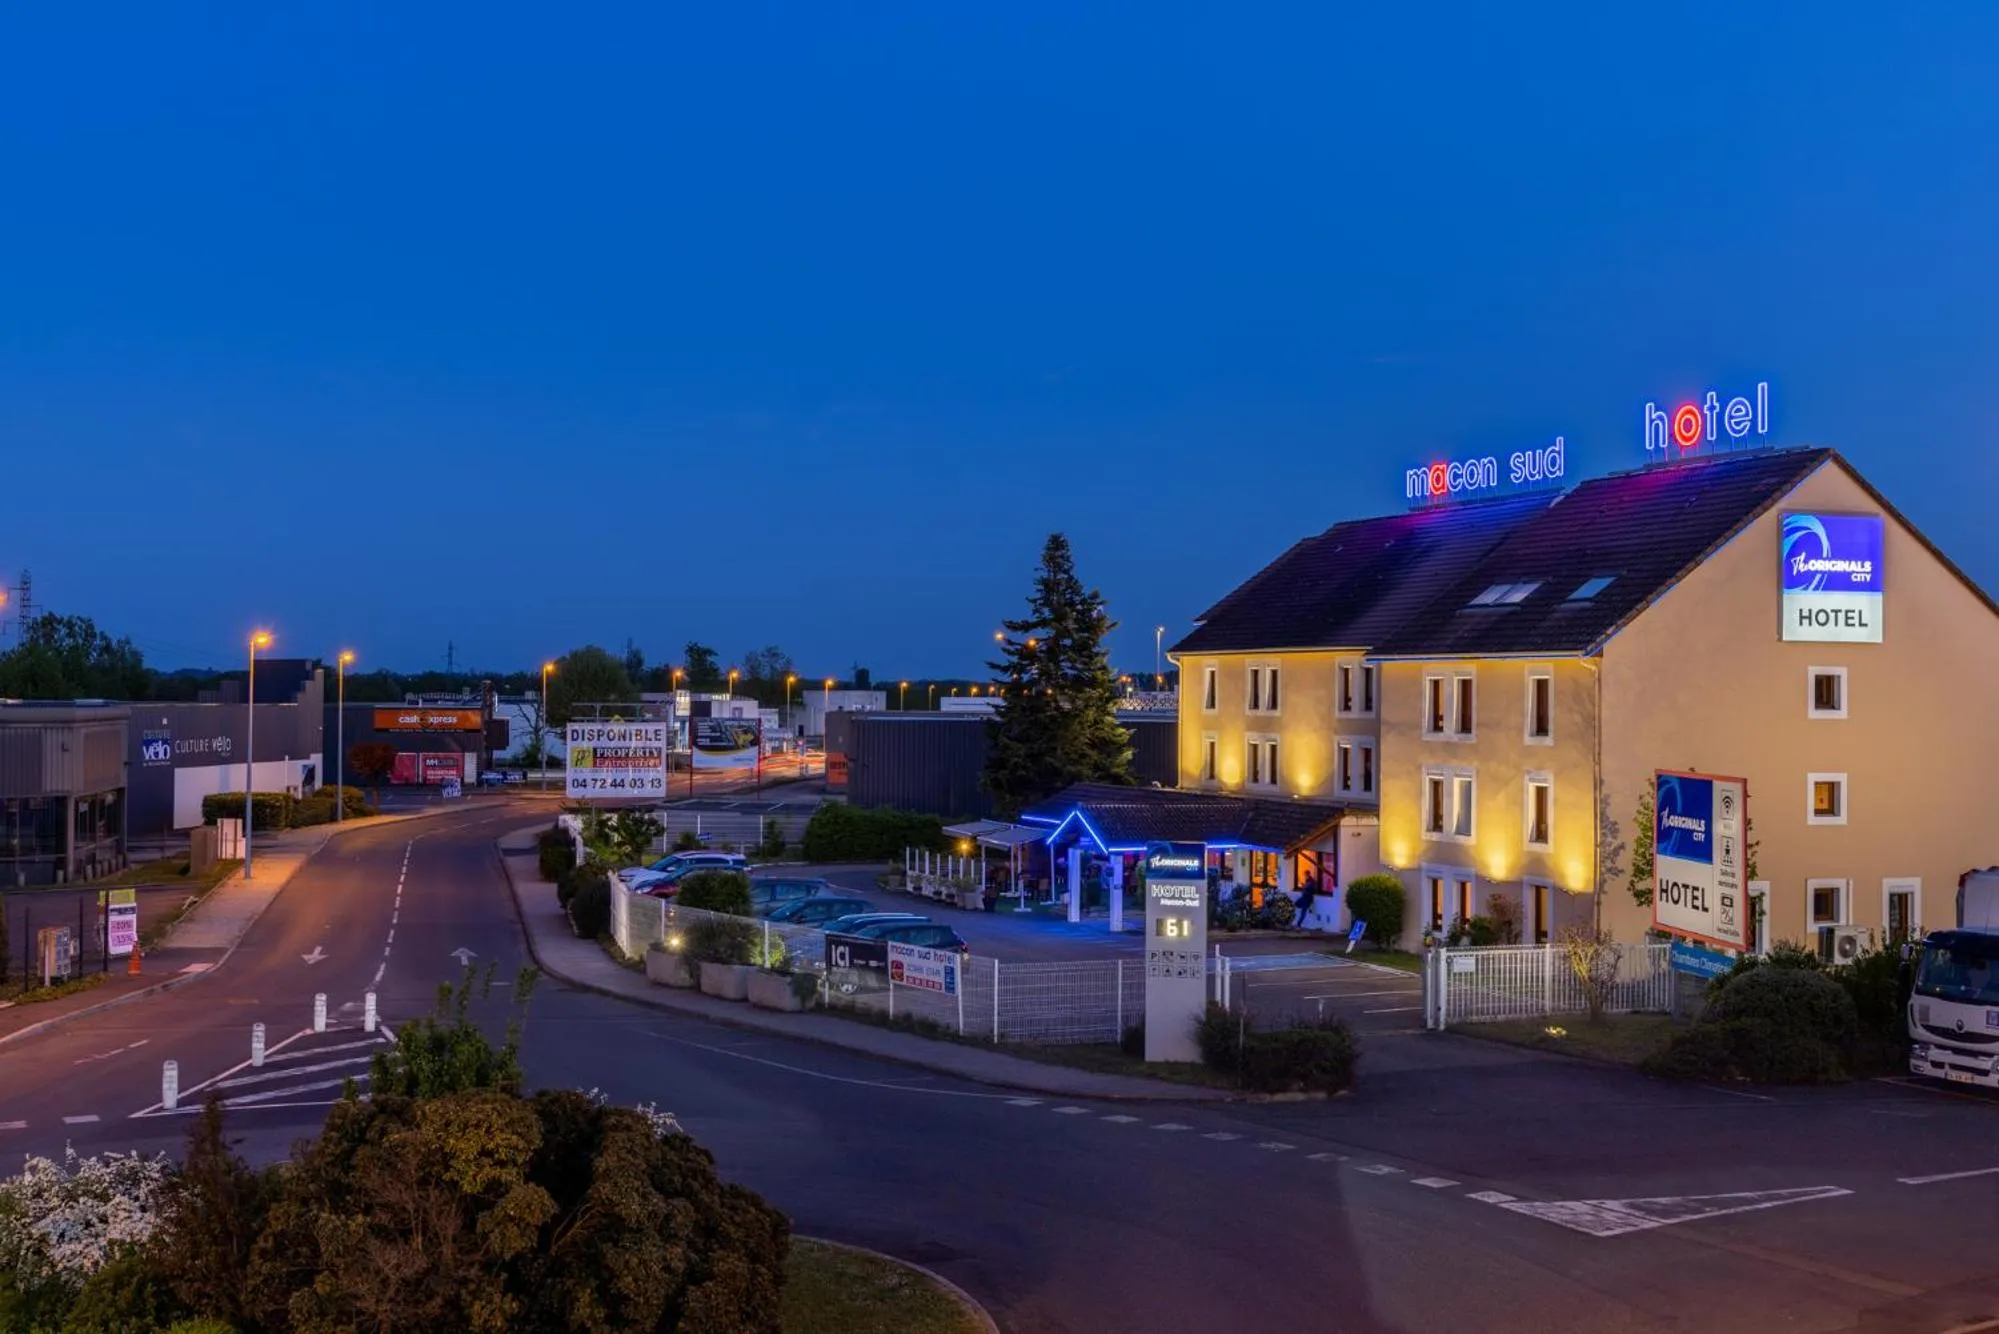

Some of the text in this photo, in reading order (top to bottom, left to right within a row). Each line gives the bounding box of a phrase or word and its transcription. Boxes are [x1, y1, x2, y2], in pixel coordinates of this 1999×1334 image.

[1645, 382, 1768, 449] hotel
[1406, 437, 1564, 498] macon sud
[1807, 559, 1872, 573] ORIGINALS
[1851, 573, 1872, 582] CITY
[1799, 608, 1868, 628] HOTEL
[399, 714, 419, 724] cash
[571, 728, 662, 742] DISPONIBLE
[175, 738, 209, 754] CULTURE
[596, 748, 659, 758] PROPERTY
[572, 778, 662, 789] 04 72 44 03 13
[1669, 814, 1706, 832] ORIGINALS
[1693, 831, 1706, 842] CITY
[1151, 884, 1200, 899] HOTEL
[1659, 877, 1710, 914] HOTEL
[832, 944, 849, 967] ICI
[890, 944, 956, 965] macon sud hotel
